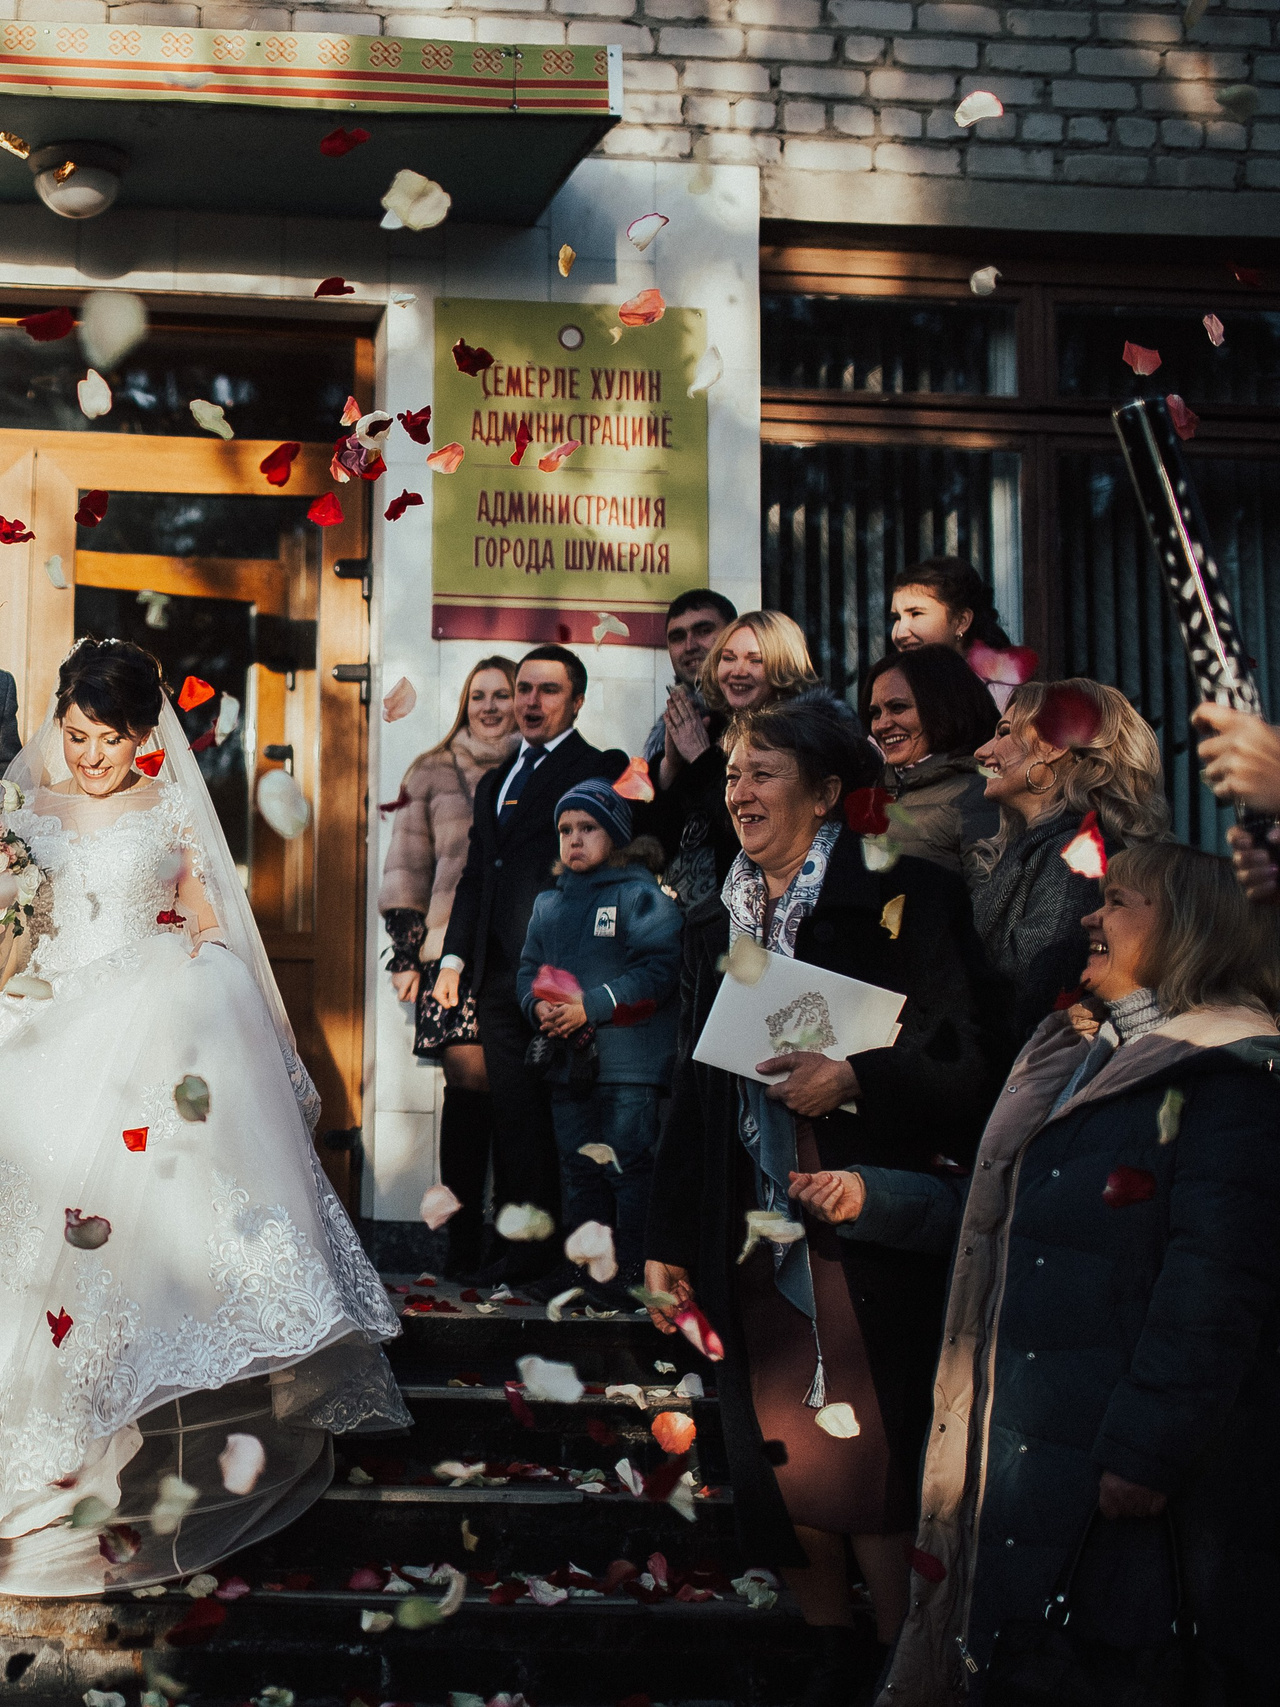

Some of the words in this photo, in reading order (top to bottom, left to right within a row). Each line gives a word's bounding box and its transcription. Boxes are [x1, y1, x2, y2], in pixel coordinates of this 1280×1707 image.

[590, 368, 662, 403] ХУЛИН
[477, 489, 666, 529] АДМИНИСТРАЦИЯ
[474, 536, 555, 574] ГОРОДА
[564, 539, 670, 575] ШУМЕРЛЯ
